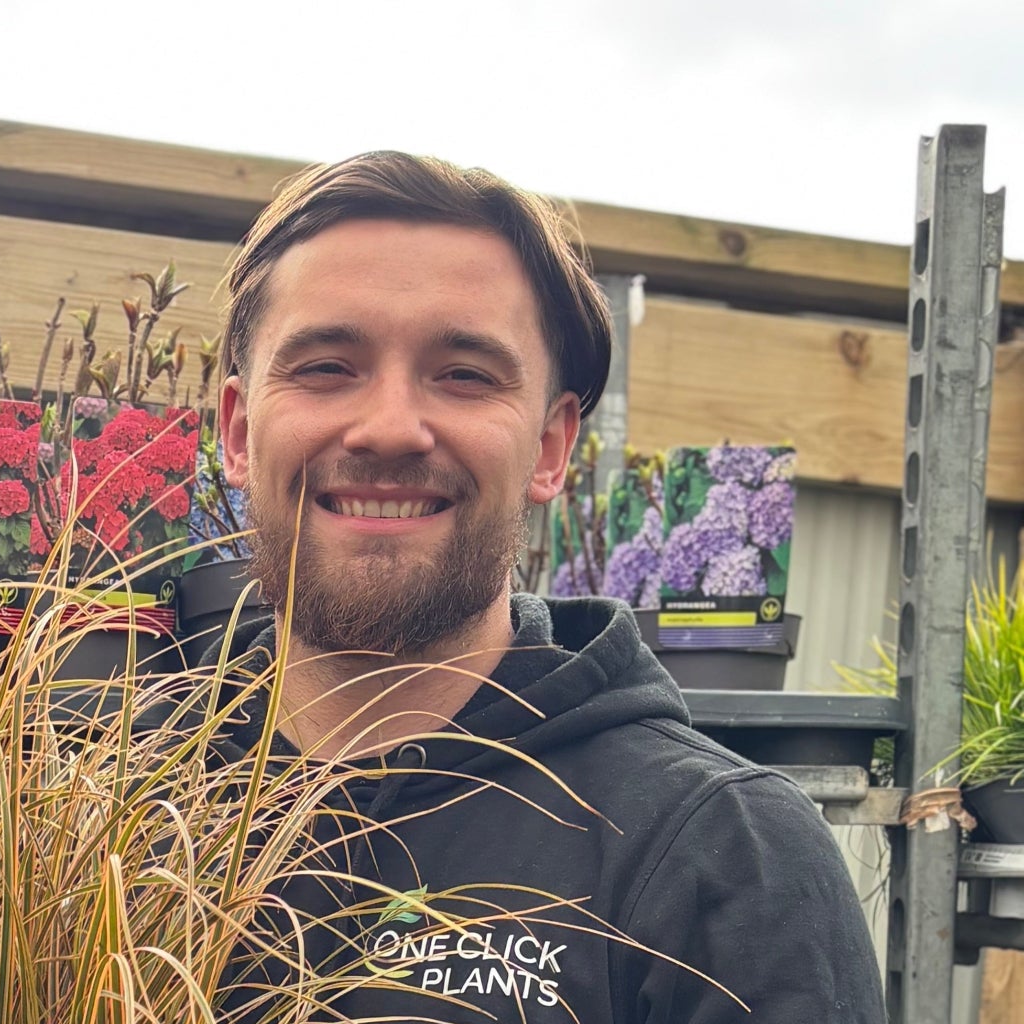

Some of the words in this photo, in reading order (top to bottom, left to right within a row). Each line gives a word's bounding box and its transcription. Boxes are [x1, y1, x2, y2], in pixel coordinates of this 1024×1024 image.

[374, 930, 450, 961] ONE
[456, 932, 567, 973] CLICK
[421, 967, 559, 1007] PLANTS
